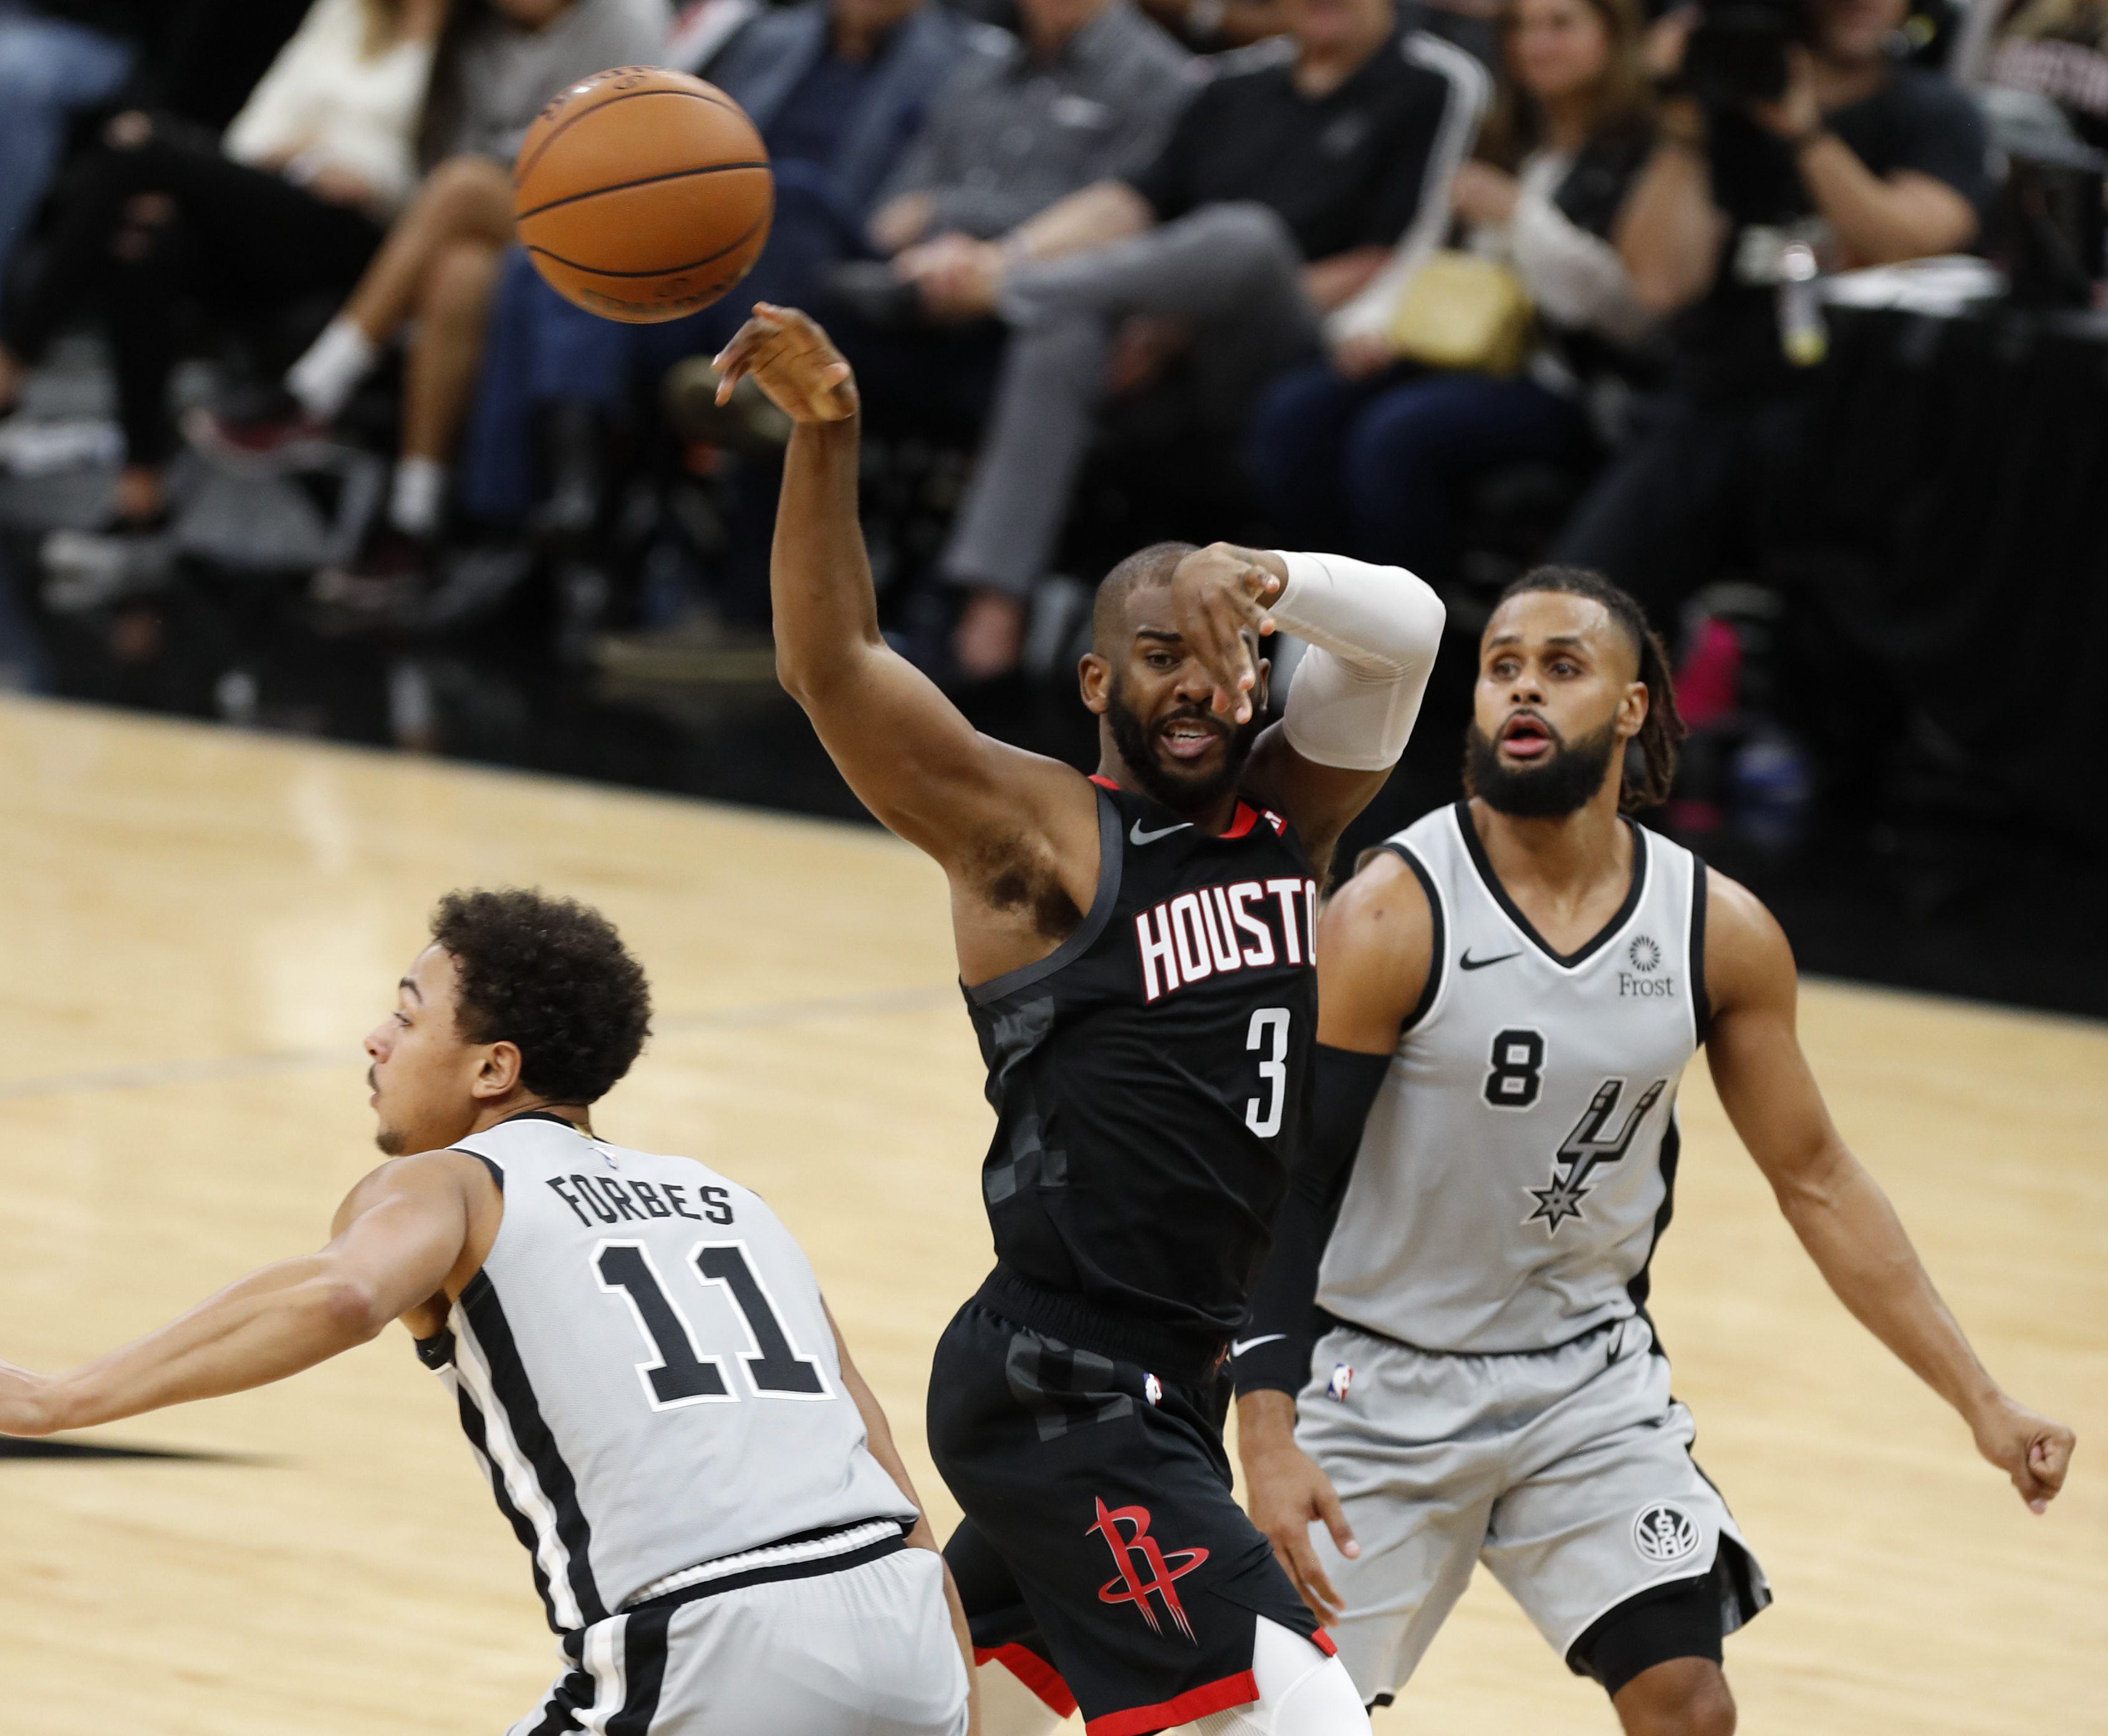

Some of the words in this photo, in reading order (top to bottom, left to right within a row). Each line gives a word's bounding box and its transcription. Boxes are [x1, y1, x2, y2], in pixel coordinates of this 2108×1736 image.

[1619, 972, 1674, 997] Frost
[1245, 1007, 1291, 1139] 3
[1482, 1026, 1546, 1111] 8
[546, 1174, 733, 1227] FORBES
[589, 1238, 837, 1412] 11
